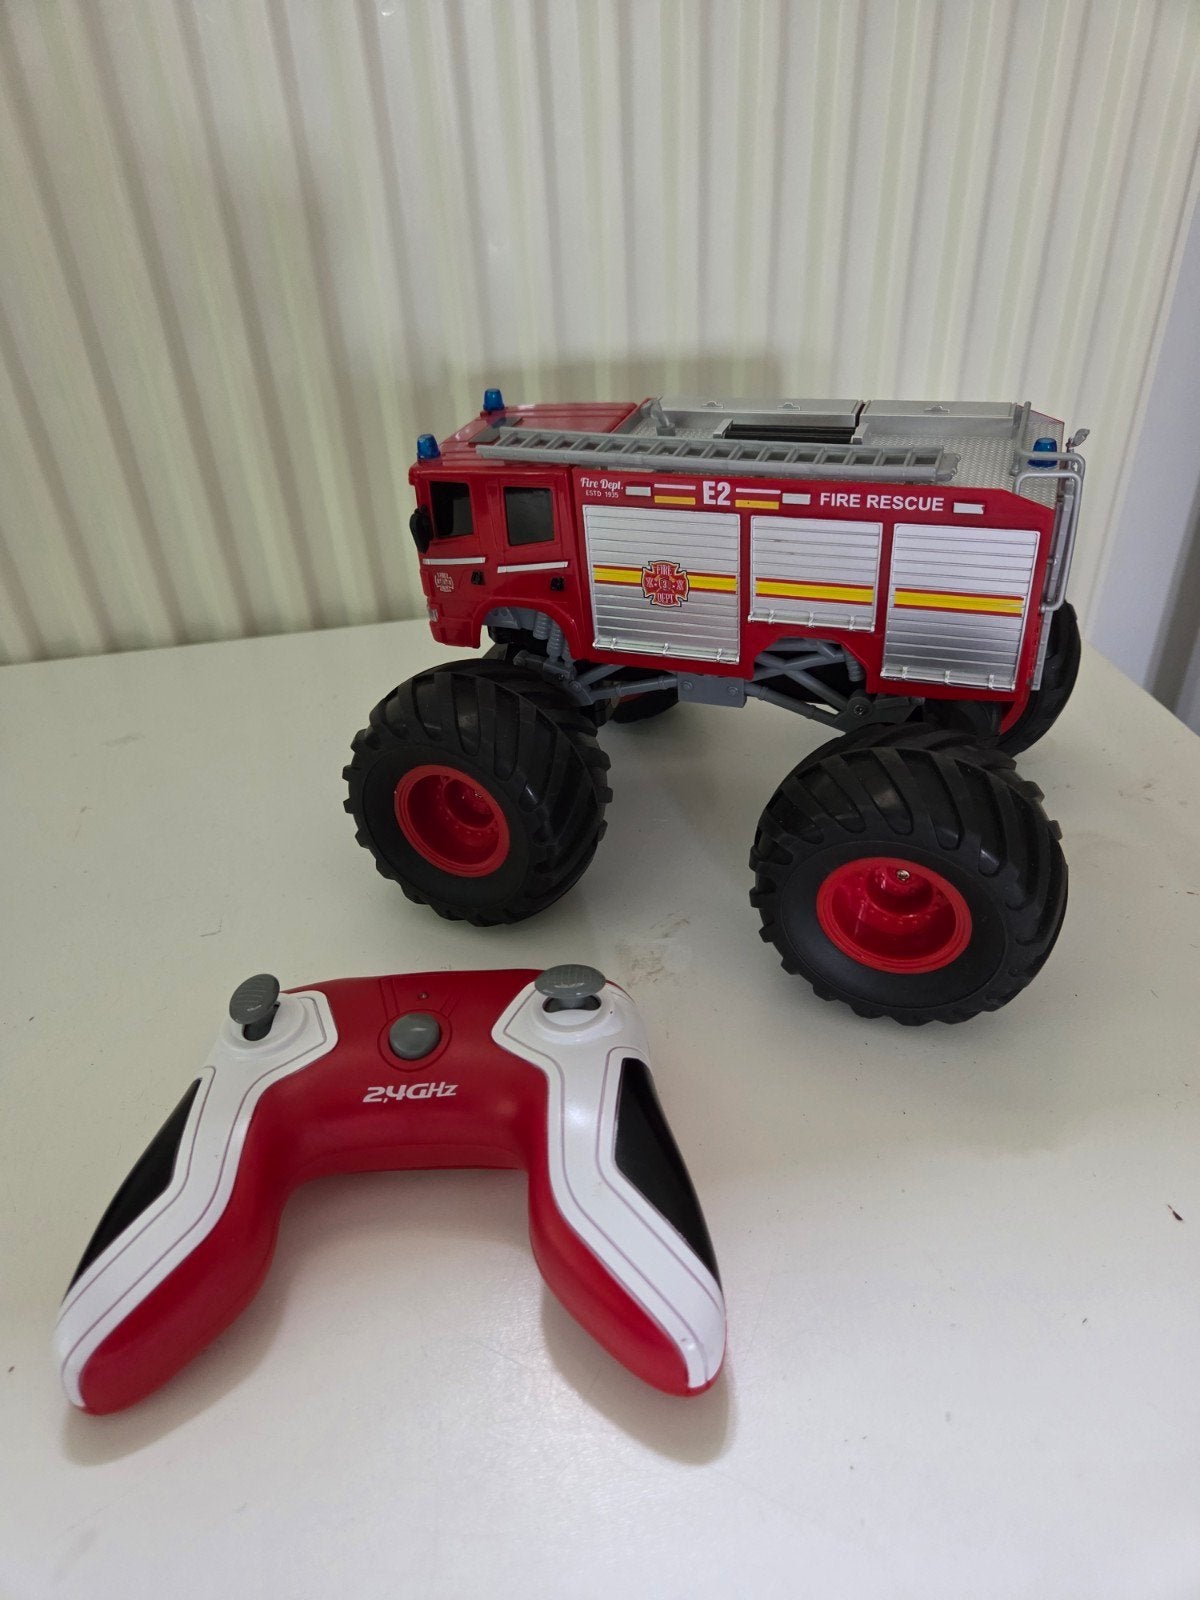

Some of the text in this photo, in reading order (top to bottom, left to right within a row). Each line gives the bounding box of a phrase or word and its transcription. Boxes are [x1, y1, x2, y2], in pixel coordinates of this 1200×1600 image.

[580, 477, 599, 489] Fire
[585, 489, 619, 499] ESTD 1935
[702, 480, 731, 506] E2
[819, 492, 945, 512] FIRE RESCUE
[656, 564, 673, 577] FIRE
